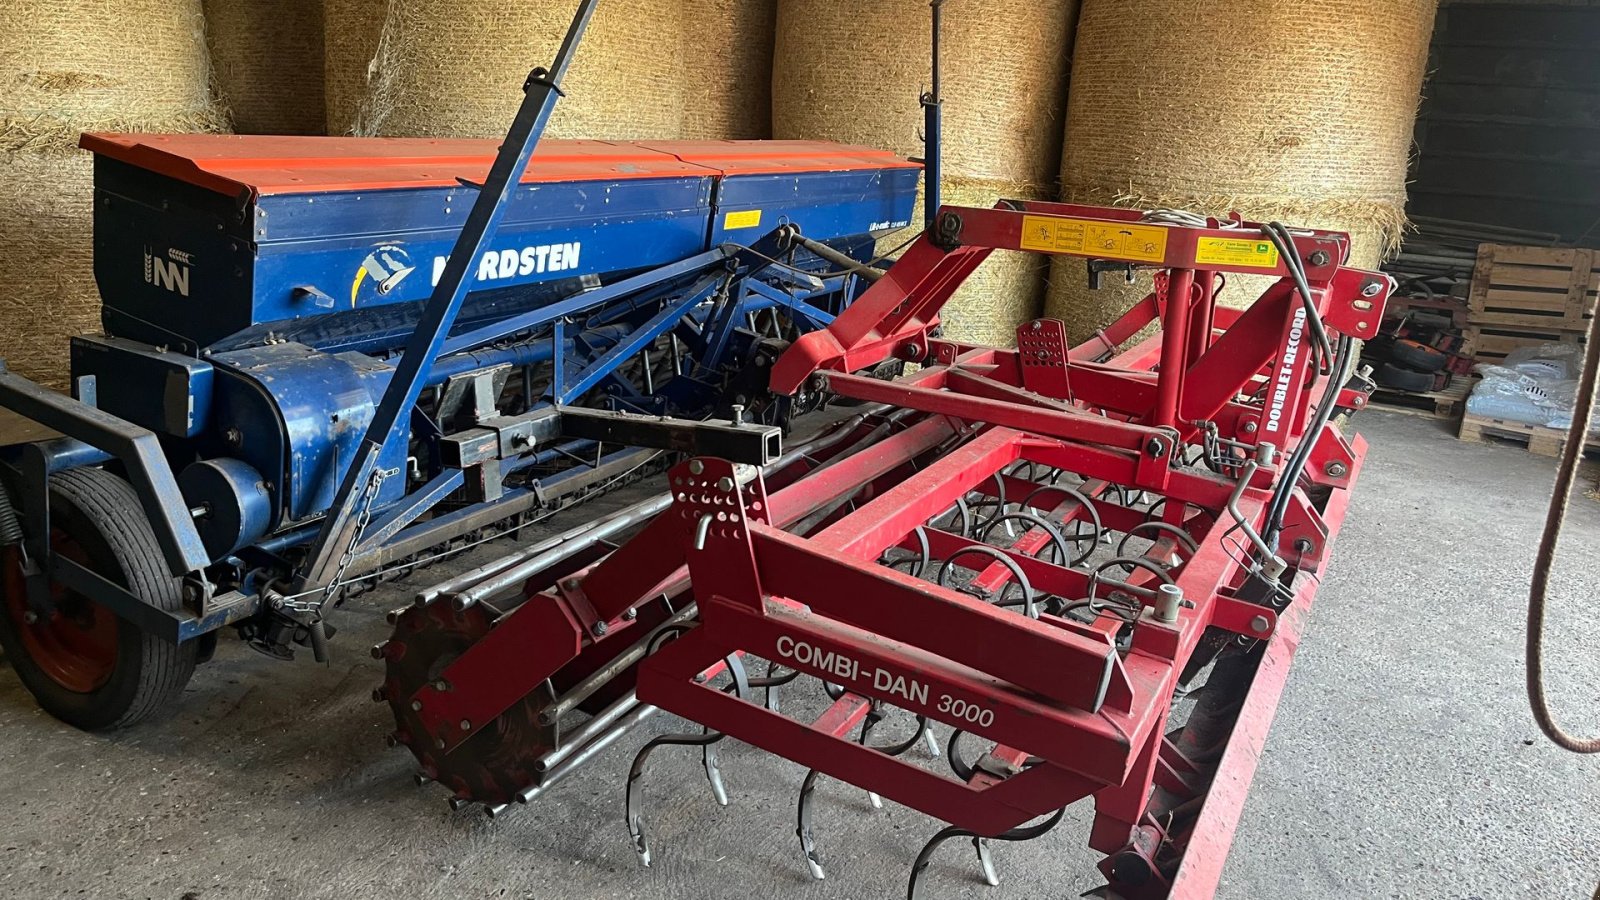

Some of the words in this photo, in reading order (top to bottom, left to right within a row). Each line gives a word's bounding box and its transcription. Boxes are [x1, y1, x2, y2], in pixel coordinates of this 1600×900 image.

[431, 242, 581, 287] NRDSTEN
[776, 636, 929, 705] COMBI-DAN
[937, 694, 995, 728] 3000
